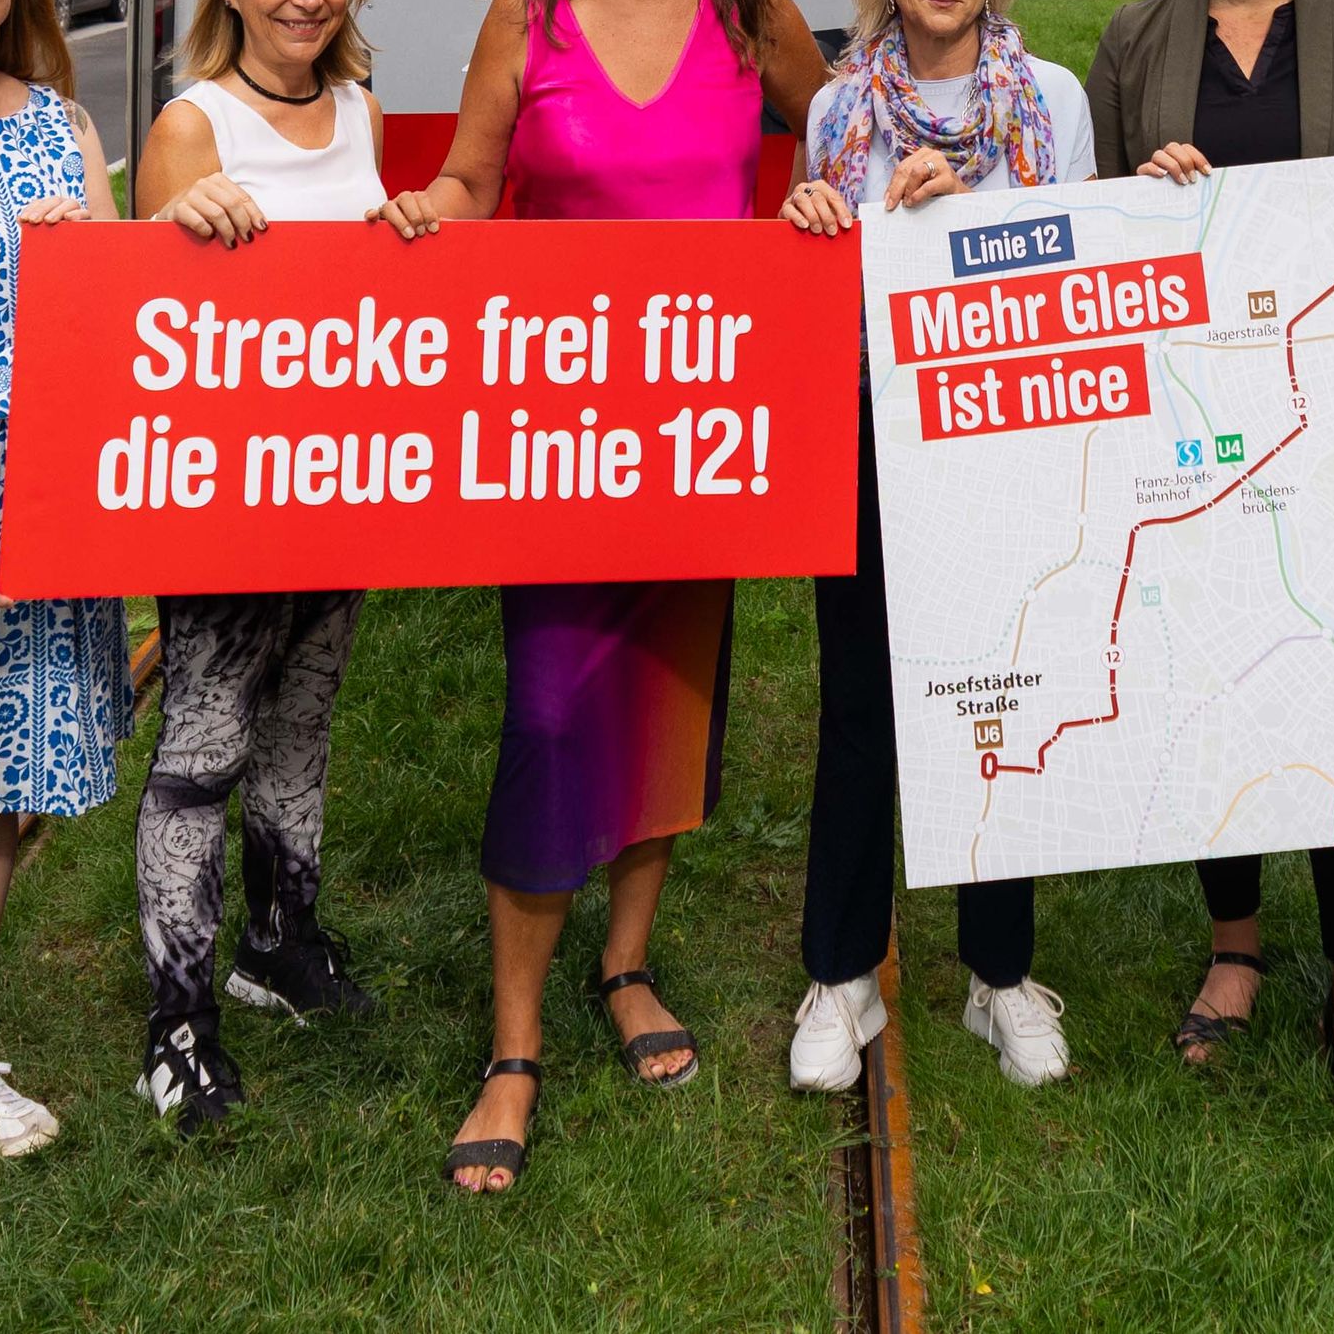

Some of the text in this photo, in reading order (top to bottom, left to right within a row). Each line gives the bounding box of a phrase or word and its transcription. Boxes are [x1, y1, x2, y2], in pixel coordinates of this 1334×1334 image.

[962, 224, 1062, 267] Linie 12
[909, 264, 1190, 356] Mehr Gleis
[1250, 296, 1274, 314] U6
[133, 293, 752, 392] Strecke frei für
[1206, 323, 1280, 343] Jägerstraße
[936, 358, 1130, 433] ist nice
[1291, 397, 1307, 410] 12
[97, 405, 770, 510] die neue Linie 12!
[1218, 439, 1242, 459] U4
[1135, 471, 1217, 489] Franz-Josefs-
[1136, 486, 1191, 505] Bahnhof
[1241, 484, 1299, 500] Friedens-
[1242, 499, 1287, 515] brücke
[1105, 651, 1121, 664] 12
[925, 672, 1043, 697] Josefstädter
[956, 695, 1019, 716] Straße
[975, 724, 1001, 745] U6
